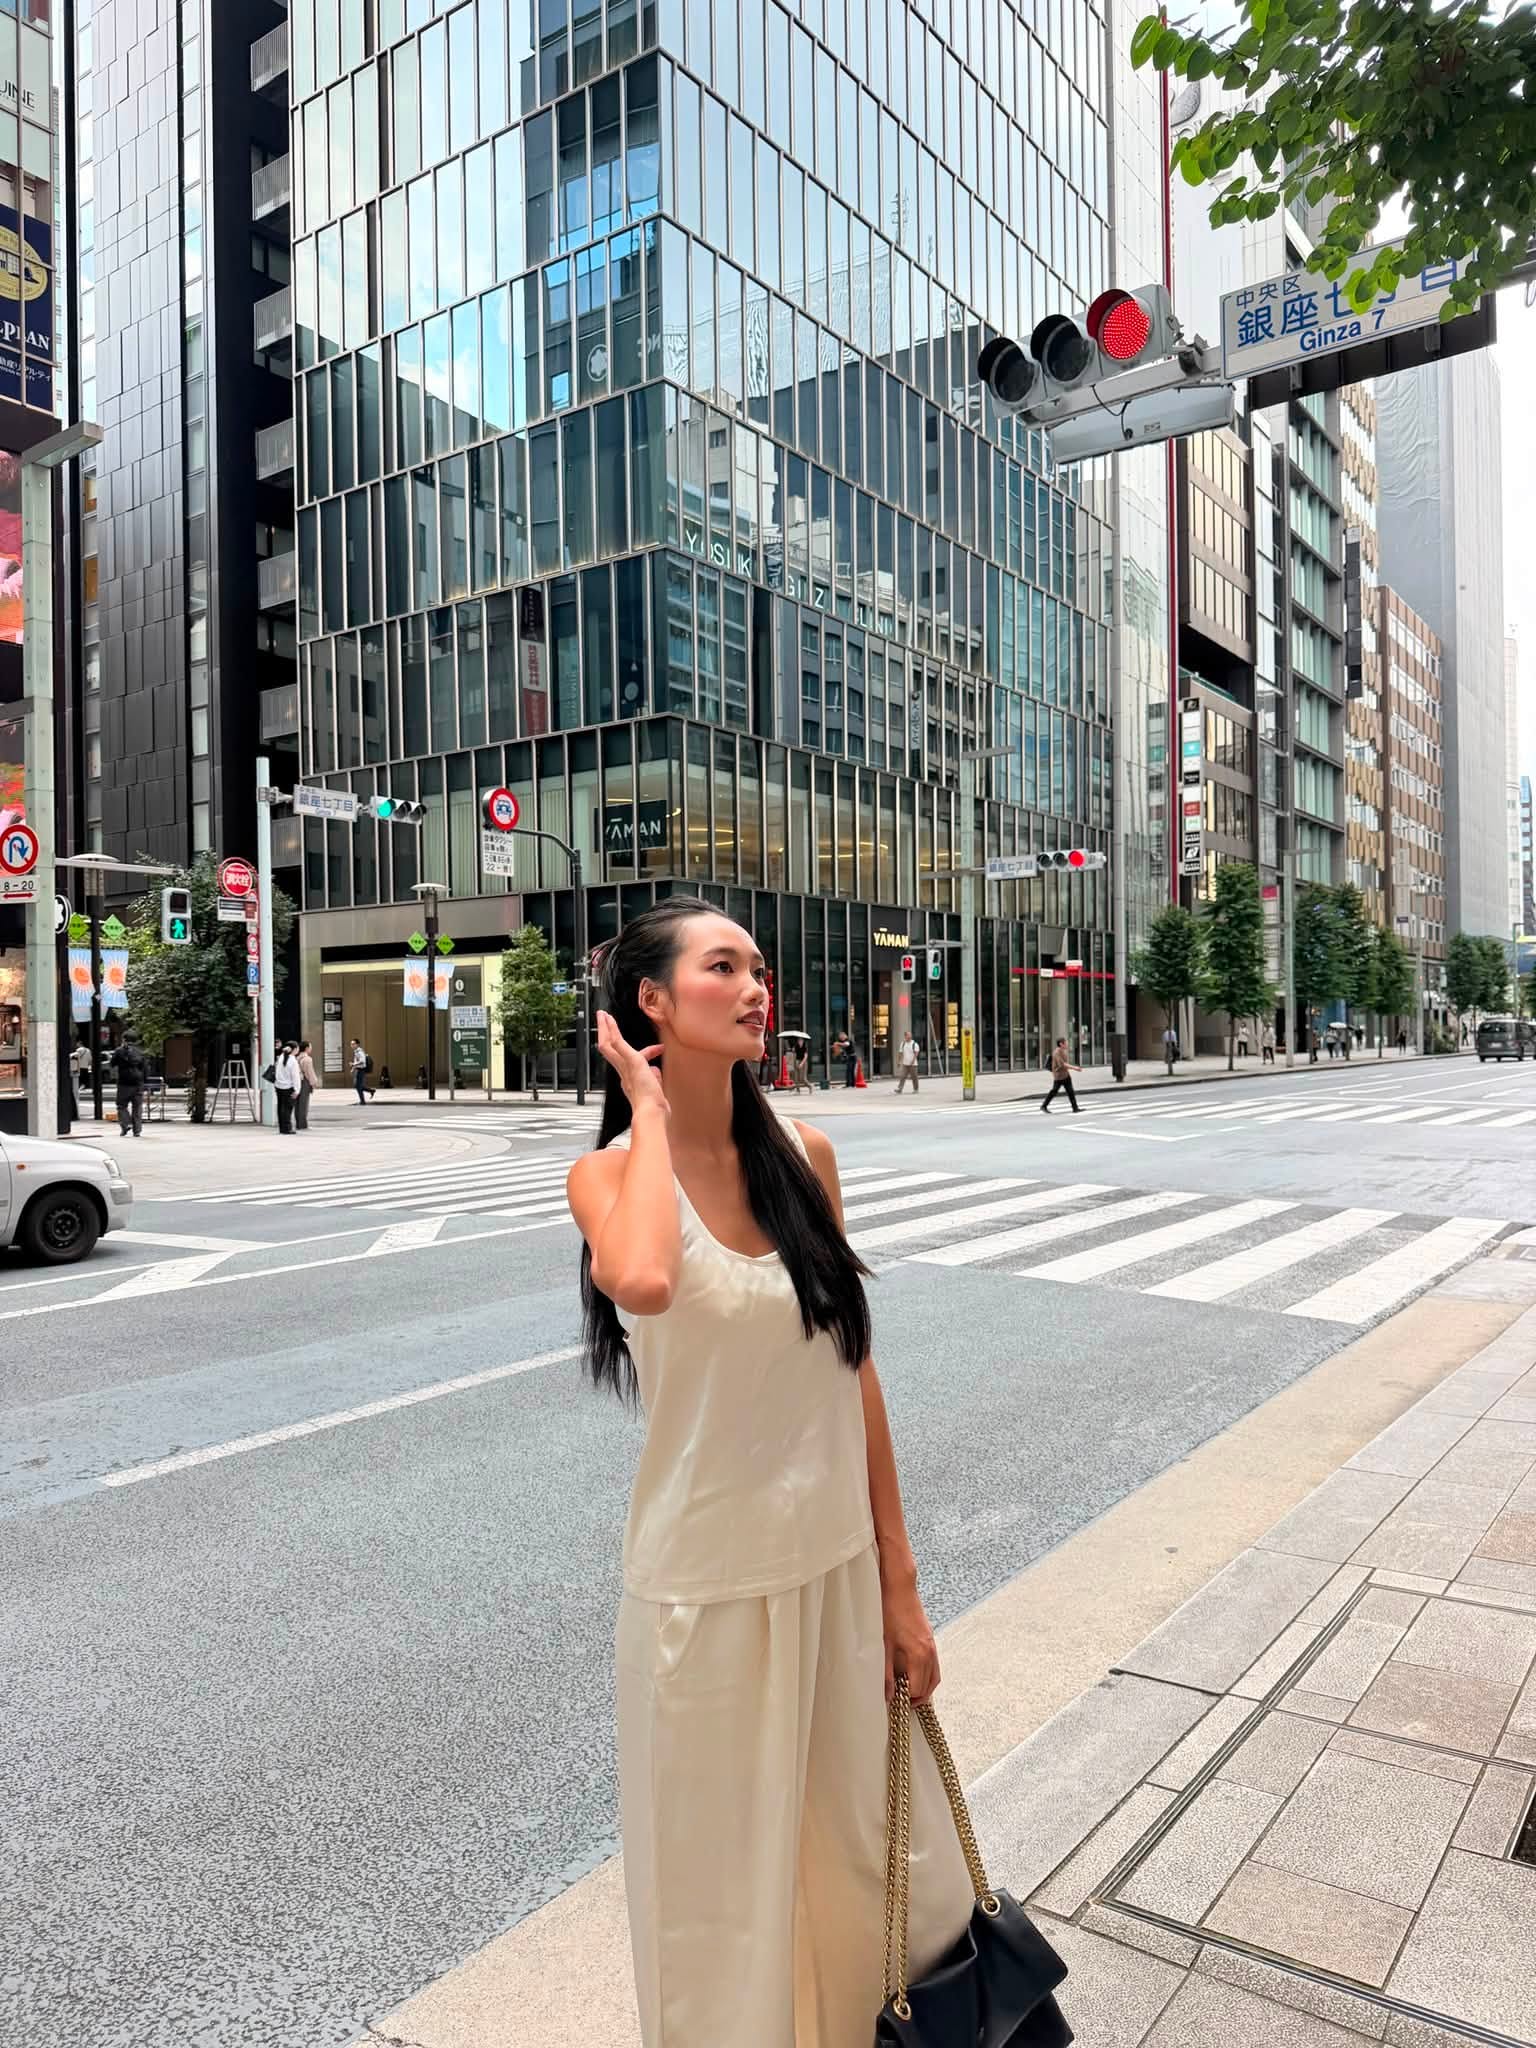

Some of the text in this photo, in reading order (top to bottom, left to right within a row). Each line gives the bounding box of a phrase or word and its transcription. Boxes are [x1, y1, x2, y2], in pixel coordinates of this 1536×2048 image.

[1236, 274, 1302, 310] 中央区
[1299, 308, 1387, 353] Ginza 7
